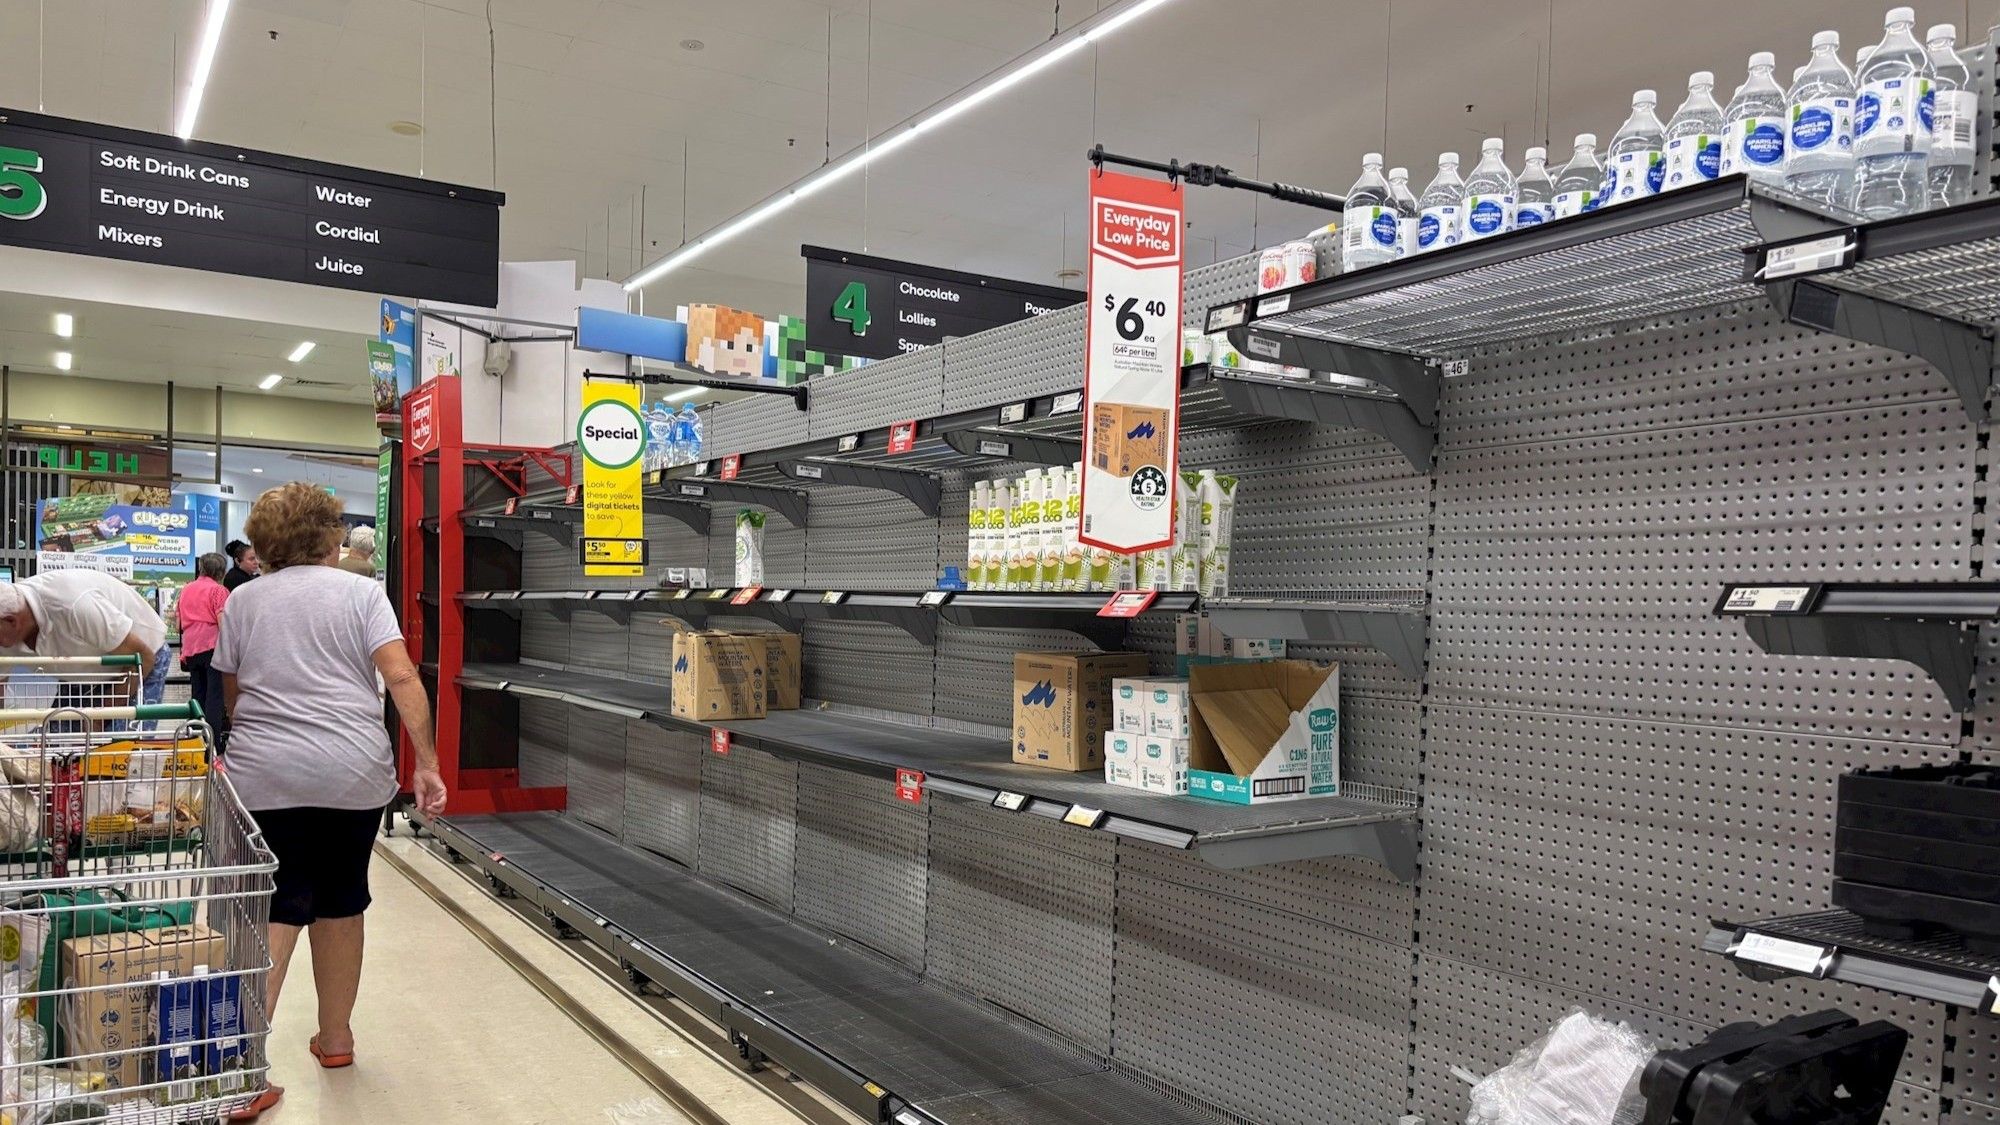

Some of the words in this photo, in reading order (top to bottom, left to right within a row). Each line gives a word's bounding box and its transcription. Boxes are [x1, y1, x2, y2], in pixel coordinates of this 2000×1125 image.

[1793, 120, 1831, 133] SPARKLING
[1795, 126, 1826, 137] MINERAL
[100, 151, 141, 171] Soft
[145, 157, 195, 181] Drink
[200, 167, 250, 189] Cans
[0, 148, 46, 220] 5
[101, 188, 169, 217] Energy
[173, 197, 224, 221] Drink
[316, 186, 371, 208] Water
[1103, 207, 1170, 236] Everyday
[99, 225, 163, 249] Mixers
[316, 221, 380, 244] Cordial
[1103, 227, 1133, 246] Low
[1136, 233, 1170, 251] Price
[315, 256, 364, 276] Juice
[900, 282, 960, 302] Chocolate
[831, 281, 871, 337] 4
[900, 310, 936, 327] Lollies
[898, 338, 929, 355] Spre
[1144, 334, 1155, 343] ea
[1129, 349, 1140, 357] per
[1141, 349, 1155, 357] litre
[1451, 361, 1462, 375] 46
[585, 425, 638, 441] Special
[586, 480, 605, 488] Look
[607, 480, 616, 488] for
[1146, 483, 1151, 493] 5
[586, 491, 608, 499] these
[610, 492, 634, 501] yellow
[586, 502, 612, 511] digital
[613, 502, 640, 510] tickets
[134, 556, 187, 566] MINECRAFT
[1310, 714, 1329, 728] Raw
[1329, 712, 1336, 727] C
[1311, 732, 1333, 751] PURE
[1311, 751, 1333, 763] NATURAL
[163, 763, 198, 771] ICKEN
[1311, 771, 1333, 784] WATER
